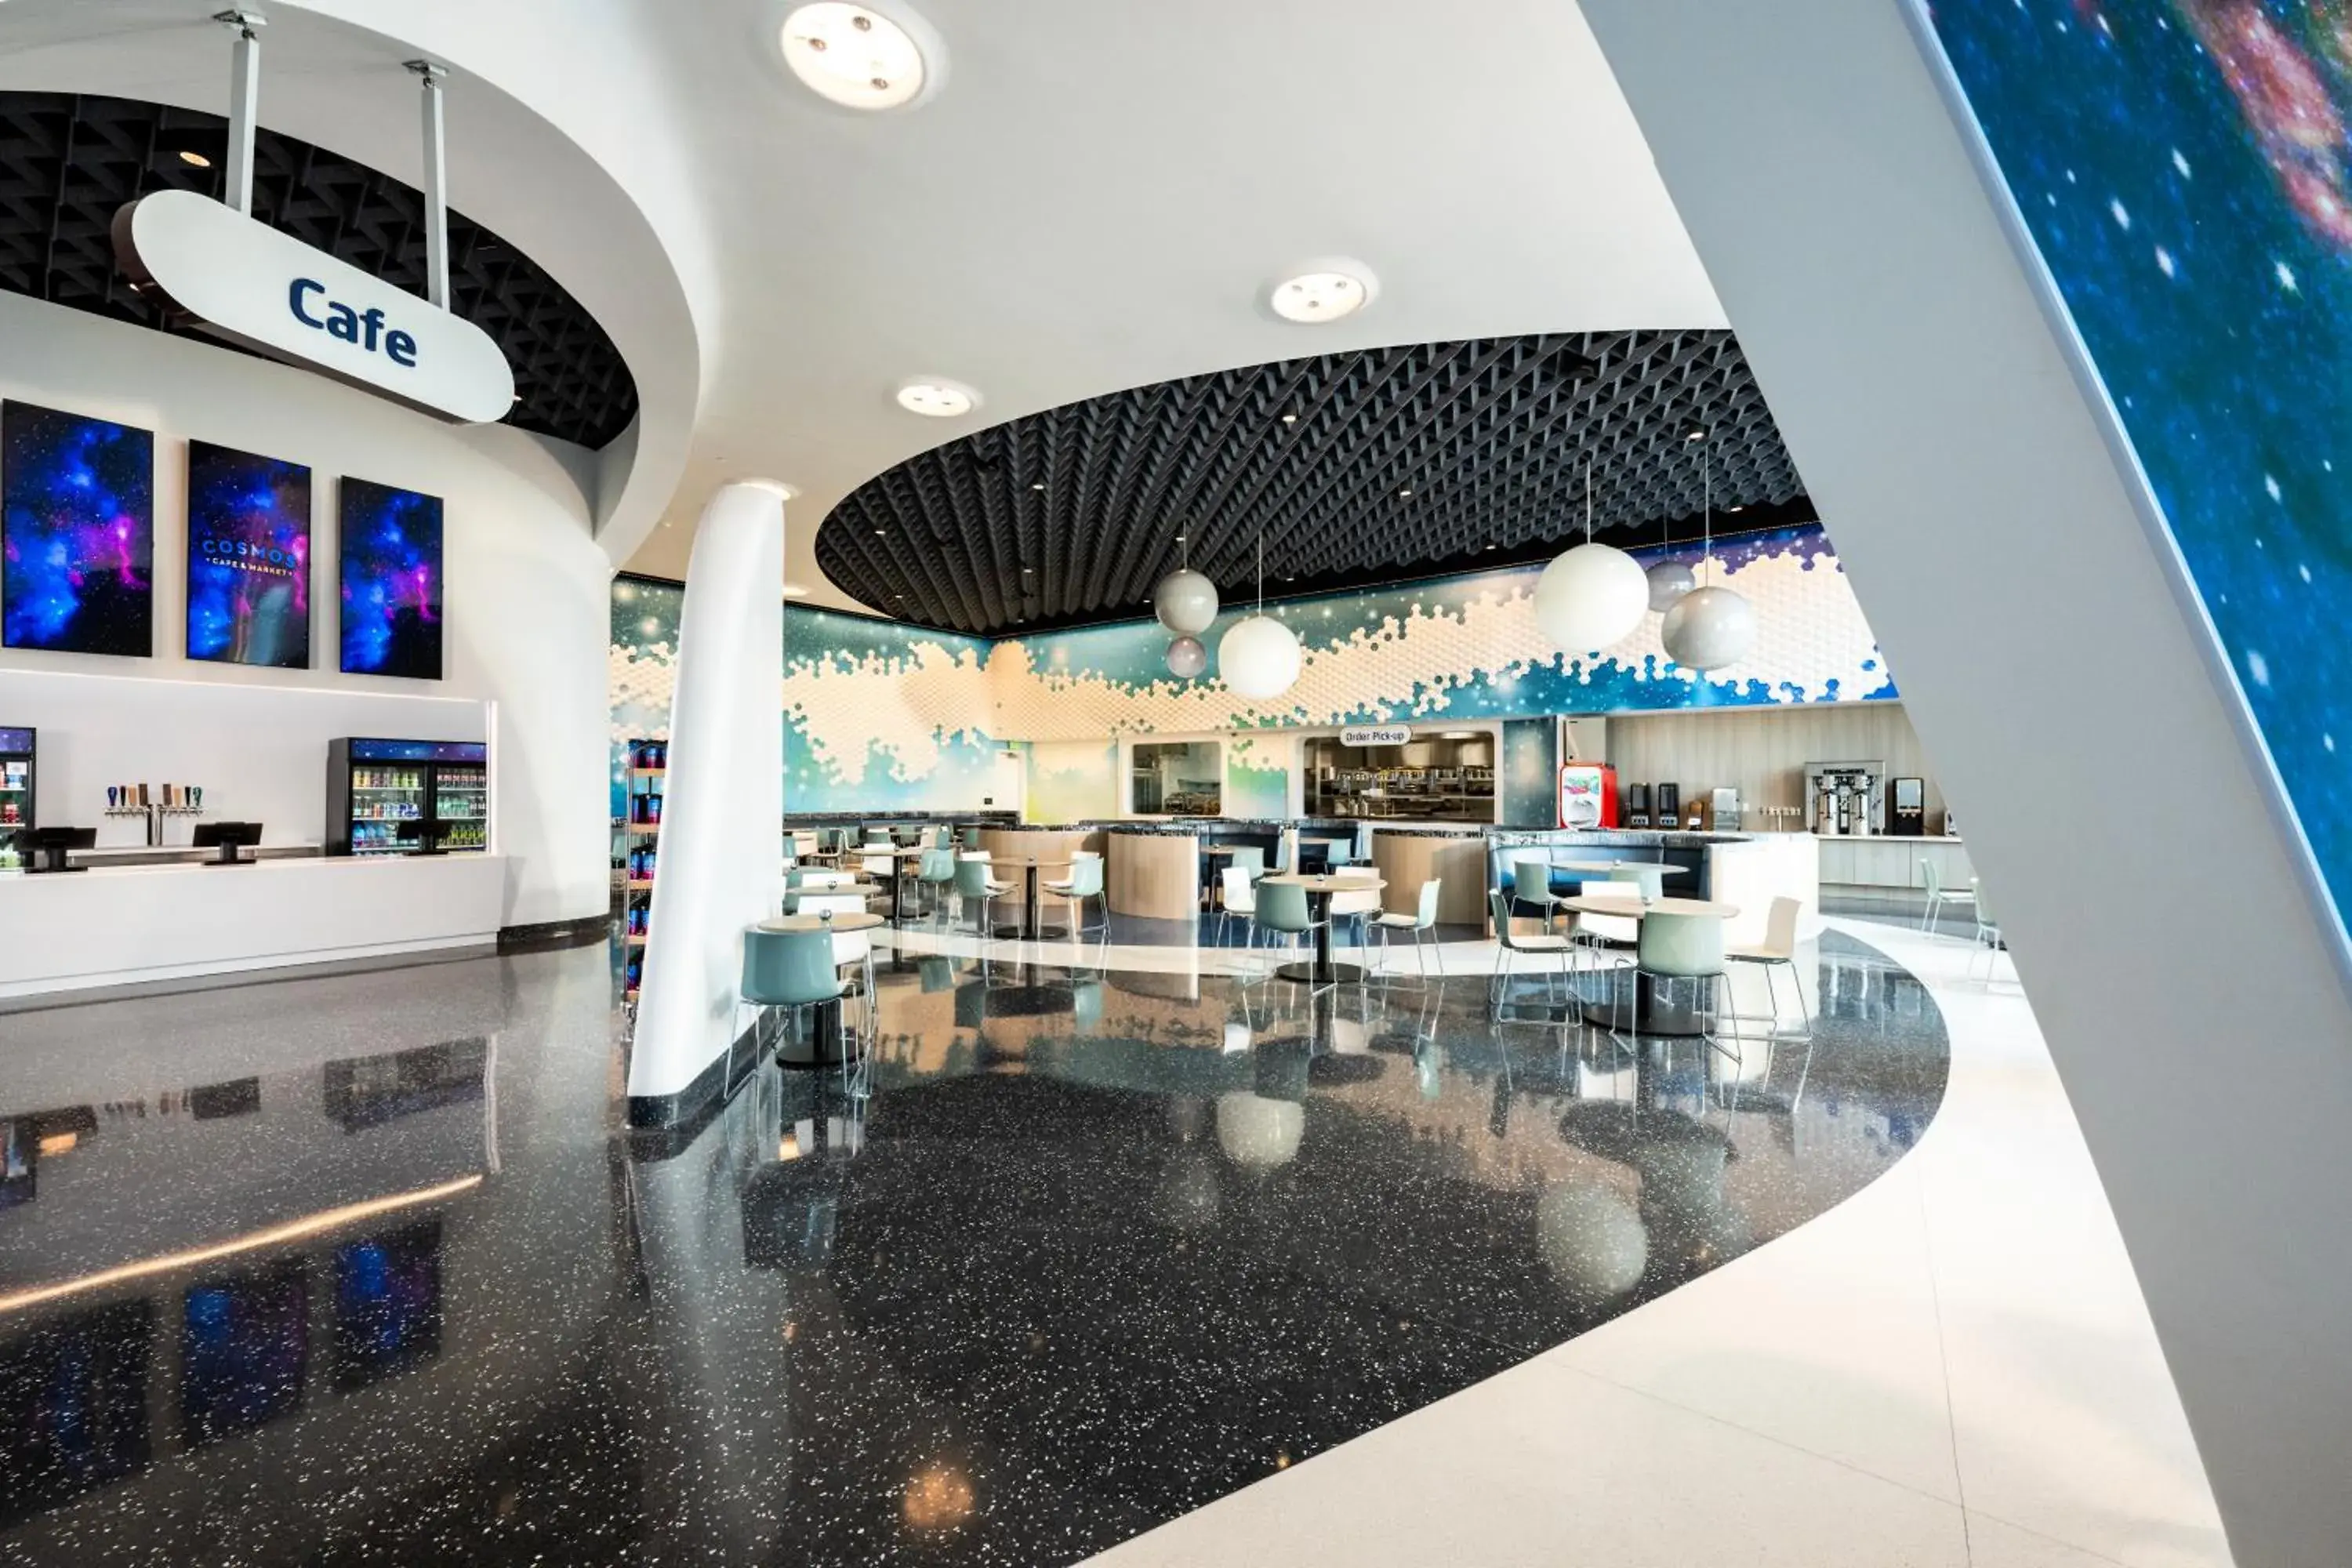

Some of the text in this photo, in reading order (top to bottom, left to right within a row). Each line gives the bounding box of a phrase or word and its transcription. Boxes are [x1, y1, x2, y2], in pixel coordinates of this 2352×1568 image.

[289, 278, 417, 368] Cafe
[202, 539, 296, 569] COSMOS
[248, 563, 287, 576] MARKET
[1346, 731, 1404, 742] Order Pick-up
